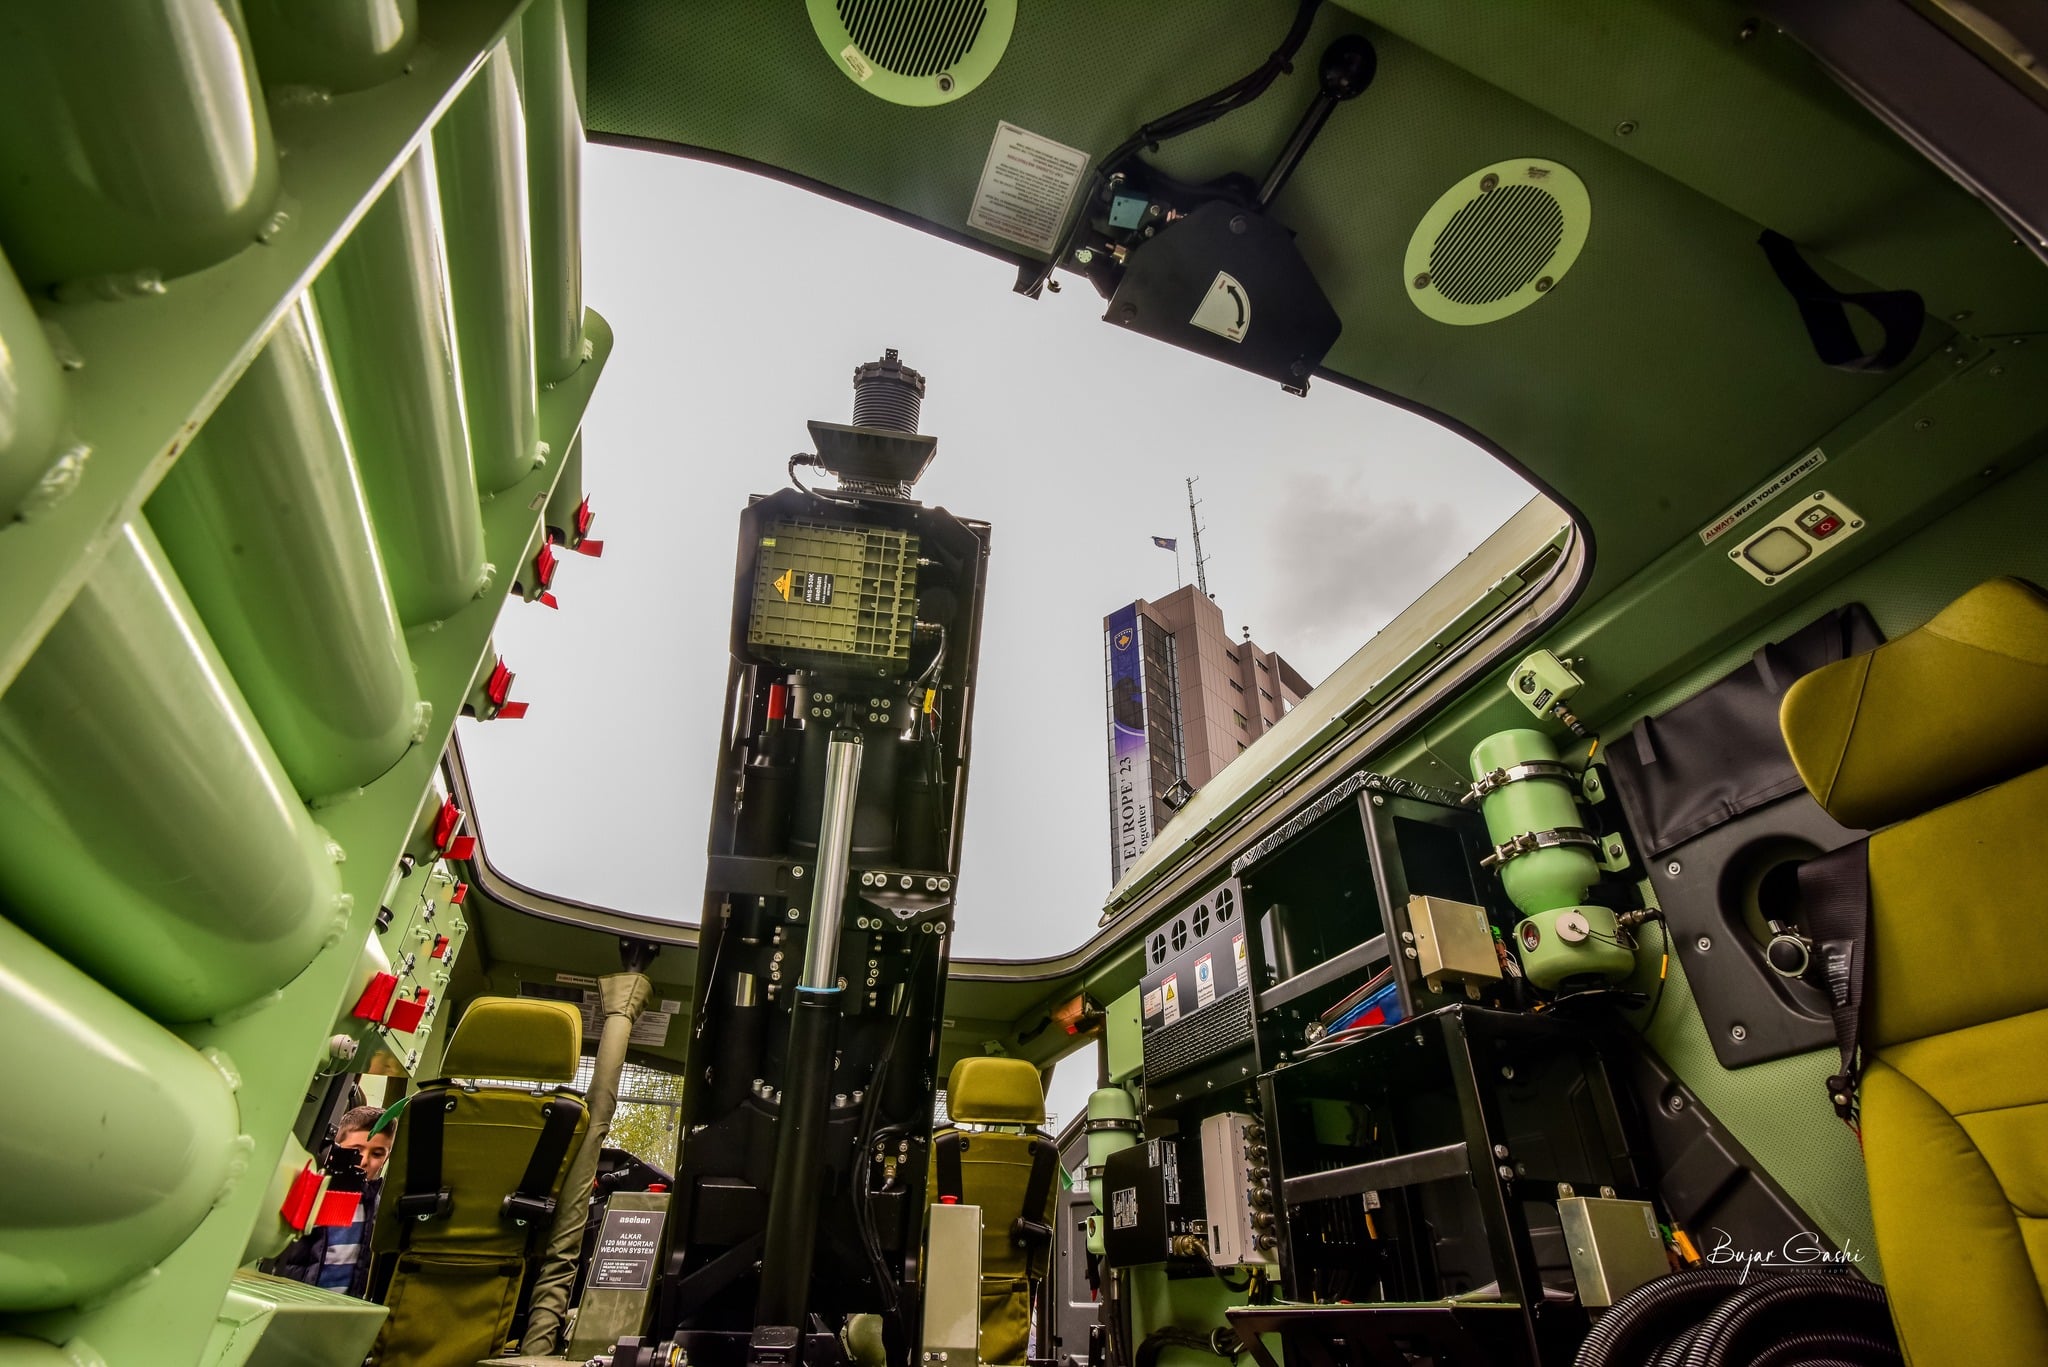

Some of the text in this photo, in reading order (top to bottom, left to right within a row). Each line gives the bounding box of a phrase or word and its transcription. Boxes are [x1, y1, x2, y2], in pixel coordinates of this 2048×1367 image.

[1705, 454, 1819, 540] ALWAYS WEAR YOUR SEATBELT
[620, 1216, 650, 1224] aselsan
